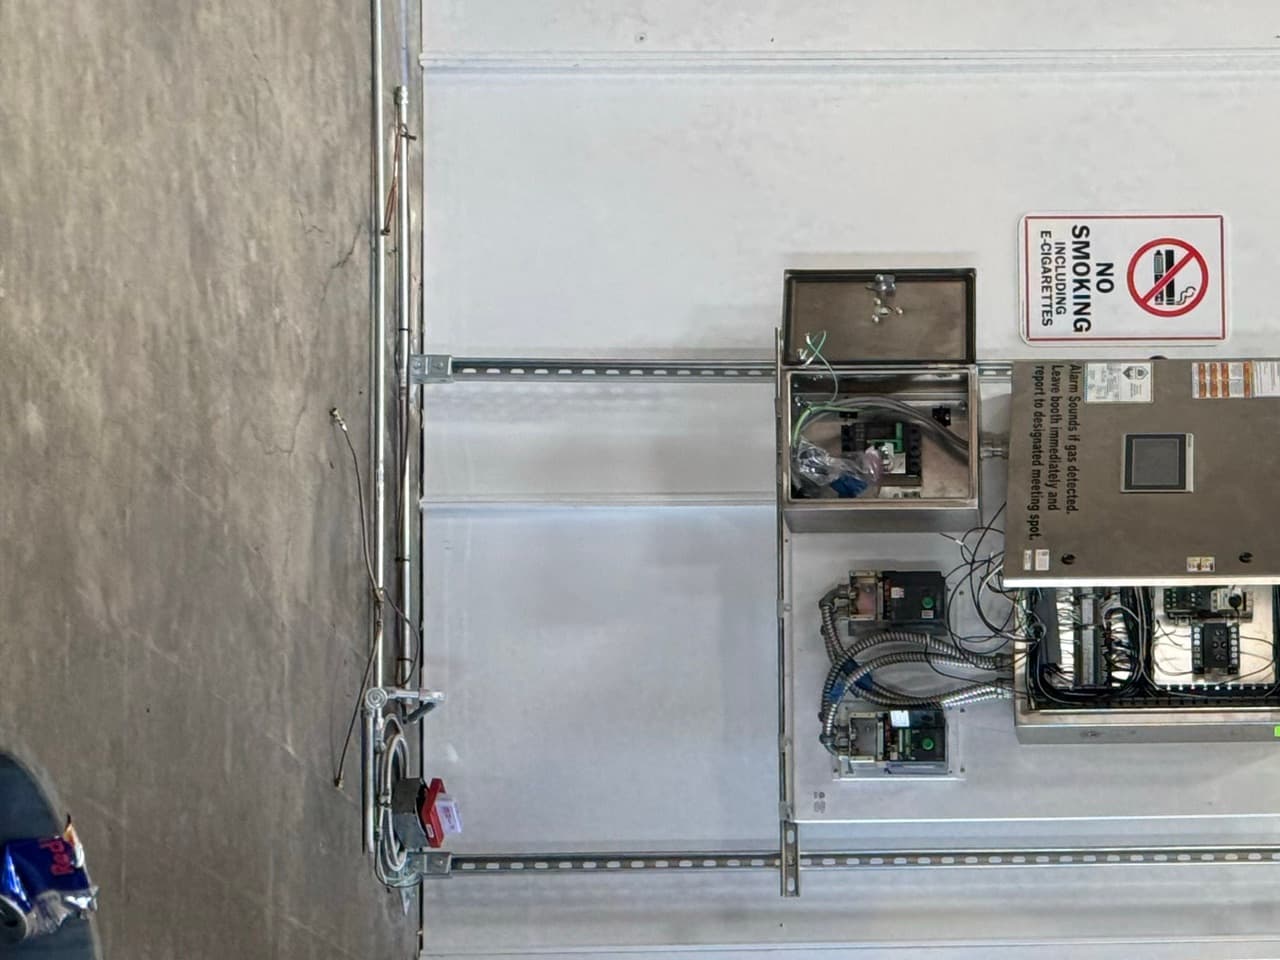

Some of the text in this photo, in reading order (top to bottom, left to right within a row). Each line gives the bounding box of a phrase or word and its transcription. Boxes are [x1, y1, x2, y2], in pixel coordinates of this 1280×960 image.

[1040, 230, 1053, 327] E-CIGARETTES
[1054, 241, 1067, 316] INCLUDING
[1071, 224, 1092, 333] SMOKING
[1095, 262, 1115, 294] NO
[1032, 365, 1046, 396] report
[1033, 398, 1046, 409] to
[1030, 411, 1046, 466] designated
[1044, 364, 1064, 511] Leave booth immediately and
[1064, 364, 1082, 515] Alarm Sounds if gas detected.
[1027, 469, 1043, 512] meeting
[1026, 513, 1042, 541] spot.
